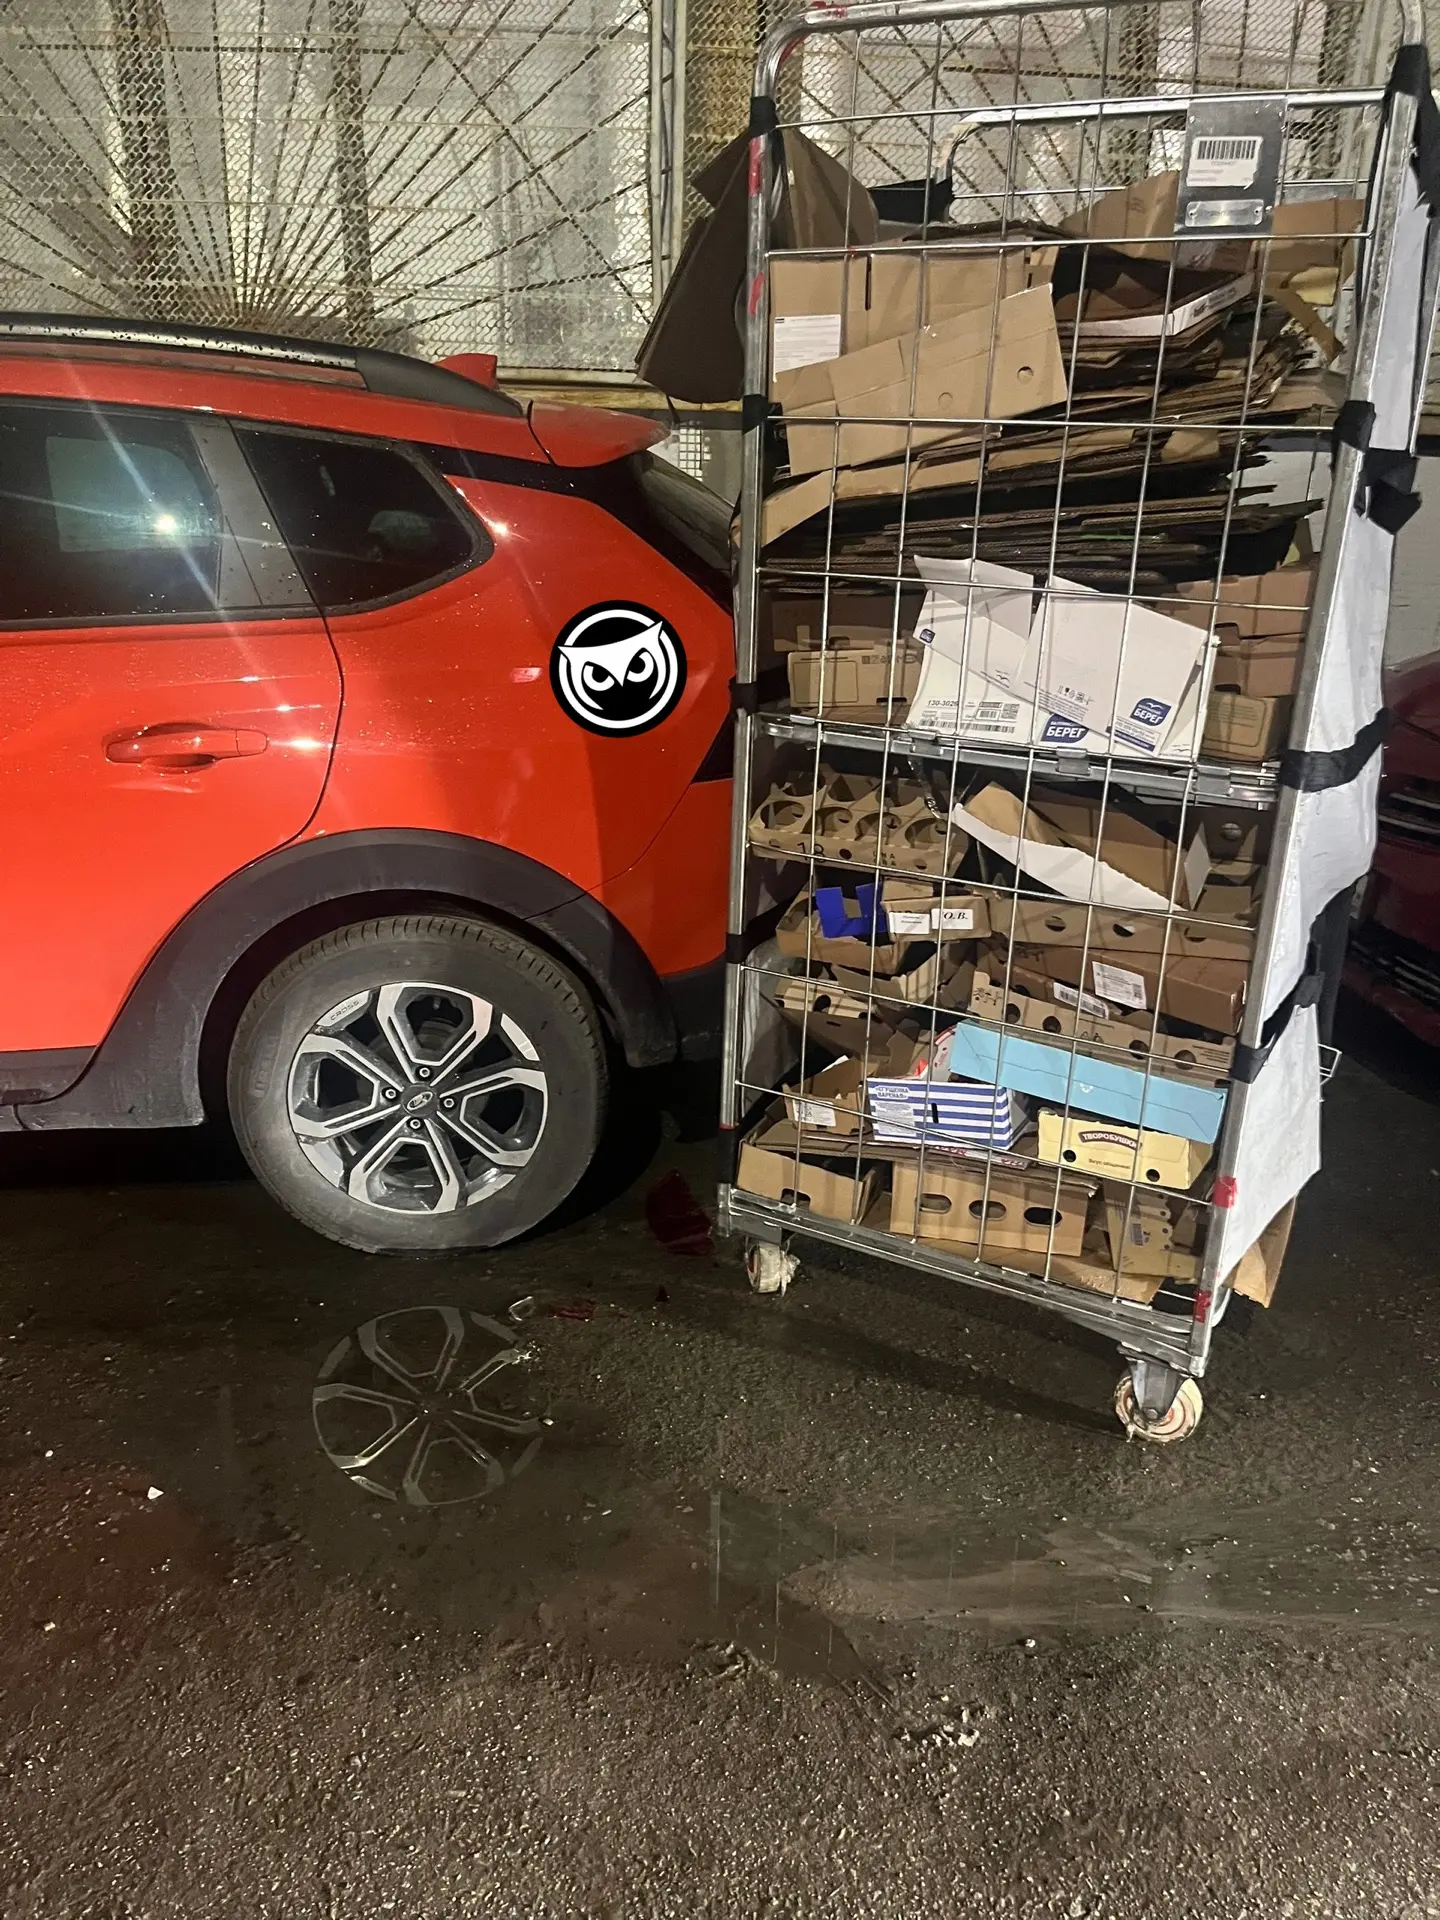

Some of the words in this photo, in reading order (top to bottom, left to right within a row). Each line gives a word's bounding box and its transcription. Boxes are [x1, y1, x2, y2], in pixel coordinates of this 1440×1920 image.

[1133, 708, 1164, 724] БЕРЕГ
[1046, 726, 1085, 738] БЕРЕГ
[330, 1000, 360, 1021] CROSS
